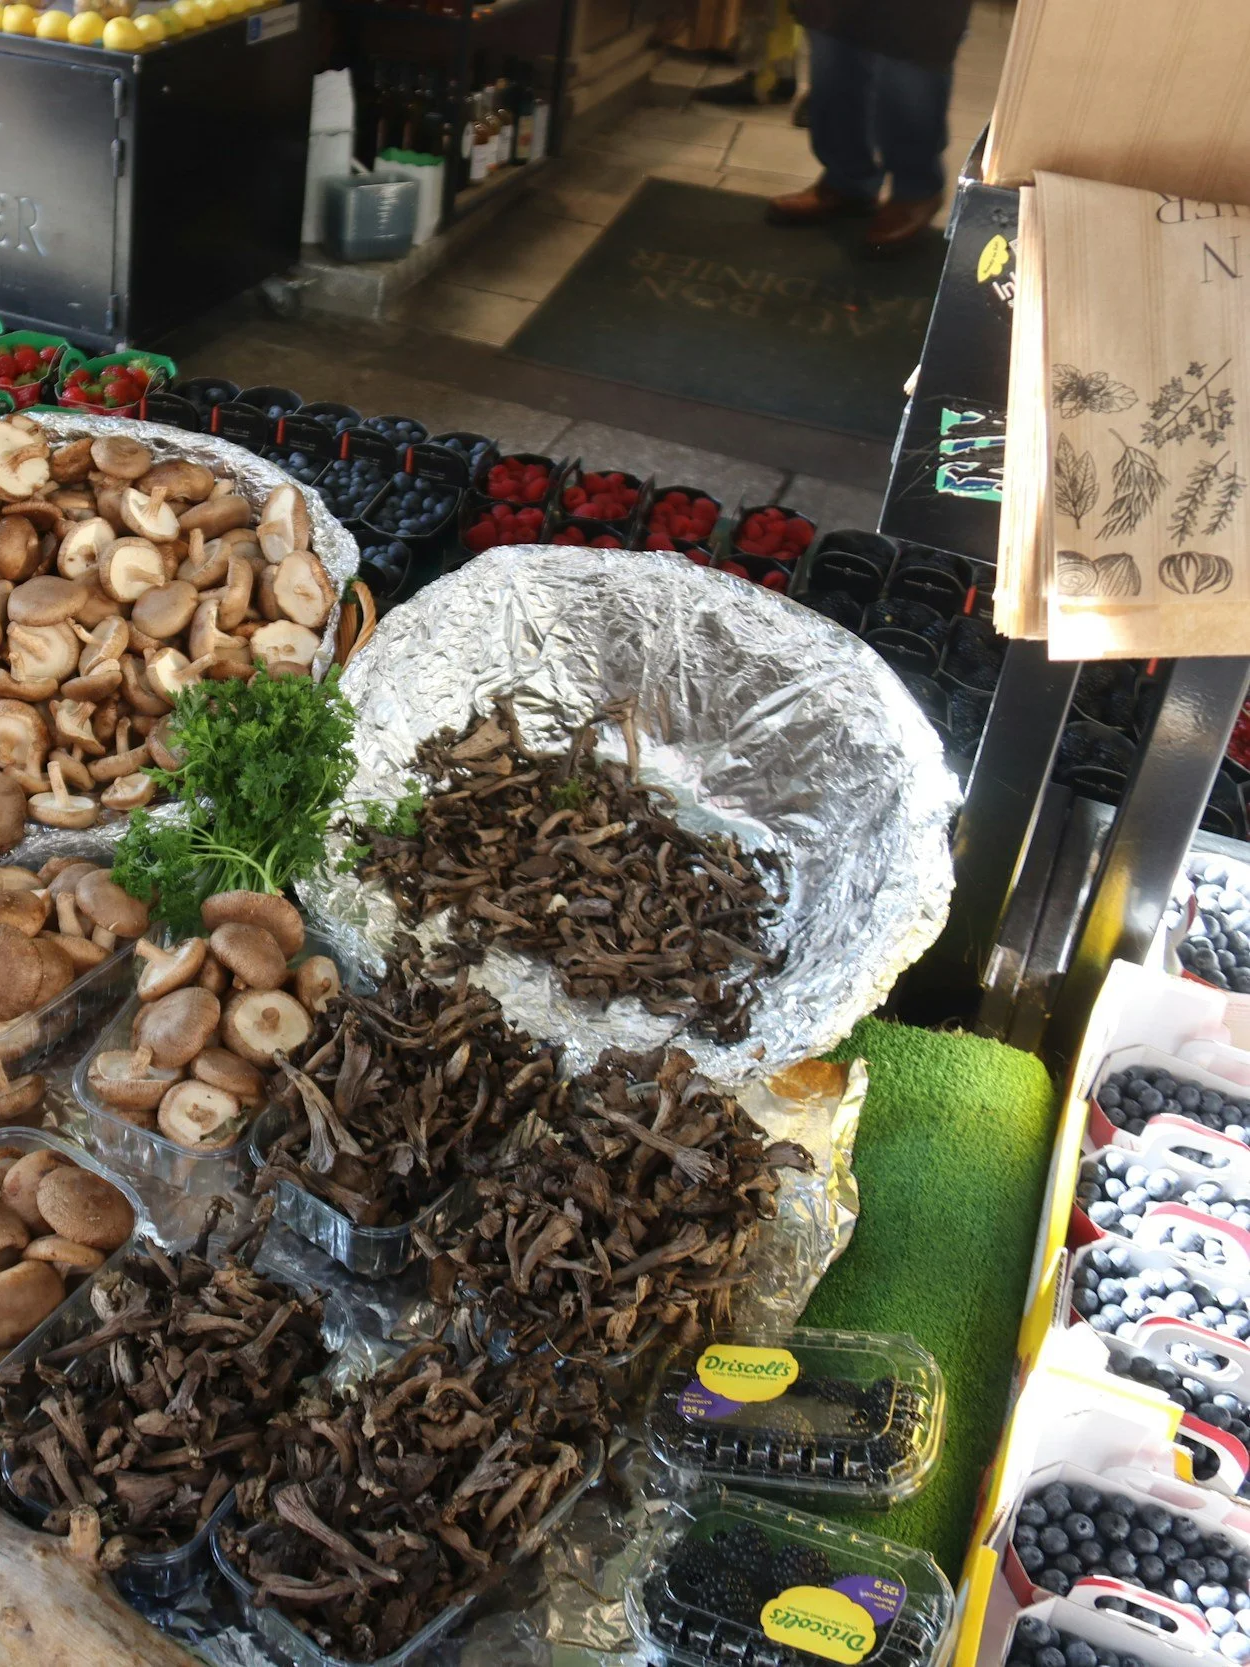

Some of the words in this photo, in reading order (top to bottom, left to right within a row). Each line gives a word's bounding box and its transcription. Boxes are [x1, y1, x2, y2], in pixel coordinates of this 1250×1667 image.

[705, 1355, 791, 1376] Driscoll's
[683, 1396, 713, 1405] Morocco
[769, 1608, 866, 1651] Driscoll's
